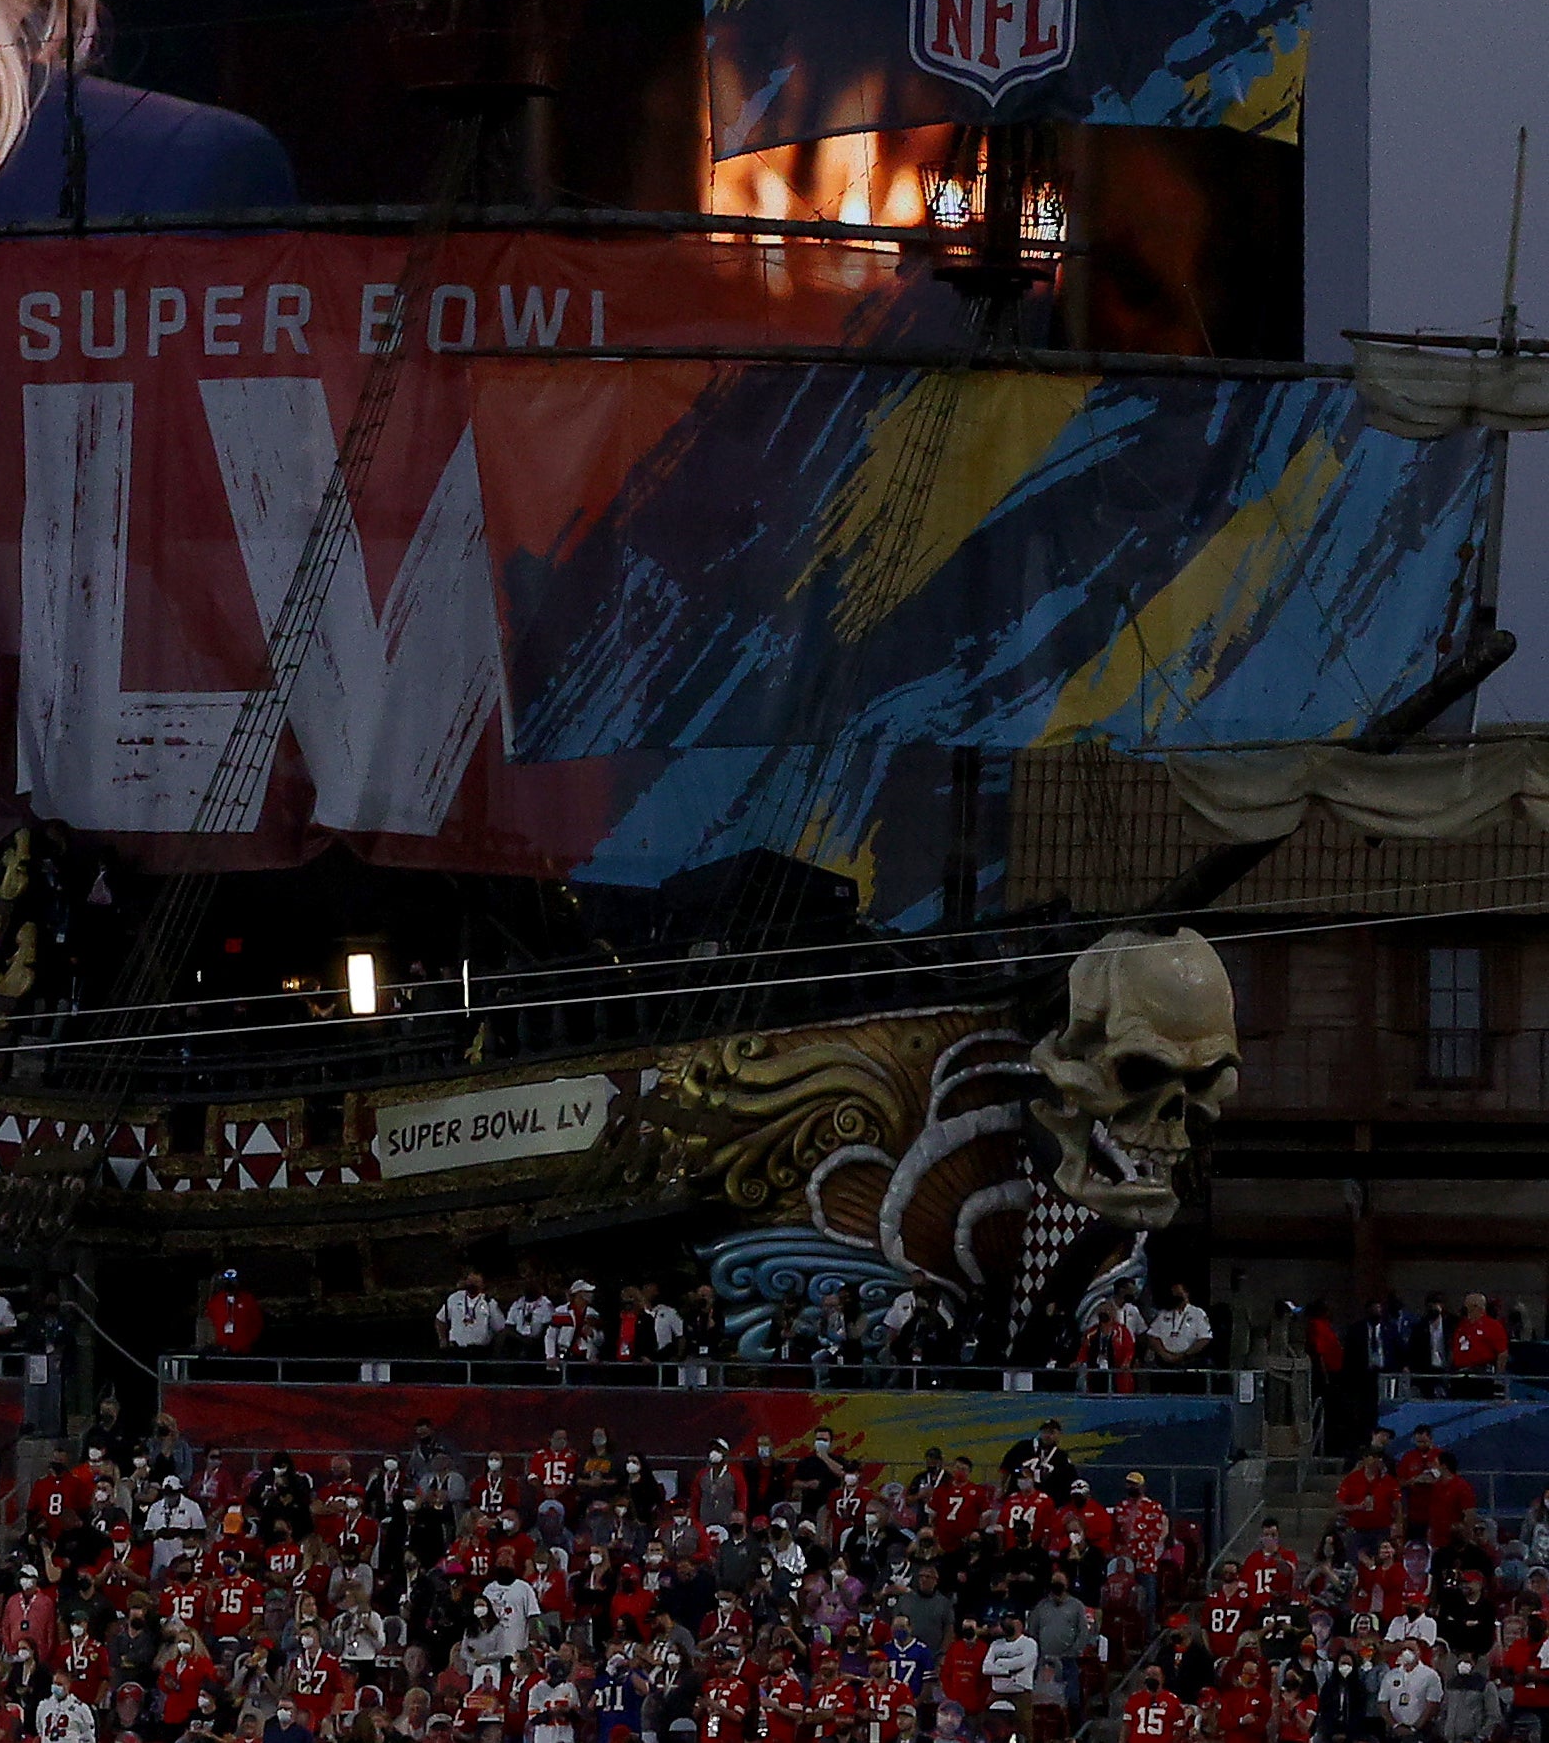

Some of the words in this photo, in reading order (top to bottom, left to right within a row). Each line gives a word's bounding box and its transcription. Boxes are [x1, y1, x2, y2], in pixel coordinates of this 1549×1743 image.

[18, 283, 314, 362] SUPER
[16, 376, 517, 837] LV
[387, 1118, 463, 1157] SUPER
[470, 1108, 546, 1141] BOWL
[557, 1102, 592, 1130] LV
[543, 1461, 566, 1485] 15
[49, 1493, 62, 1515] 8
[947, 1496, 963, 1520] 7
[471, 1555, 489, 1576] 15
[1255, 1569, 1277, 1594] 15
[172, 1596, 195, 1619] 15
[220, 1588, 243, 1613] 15
[1211, 1609, 1240, 1633] 87
[889, 1660, 916, 1684] 17
[869, 1694, 891, 1720] 15
[1137, 1707, 1167, 1735] 15
